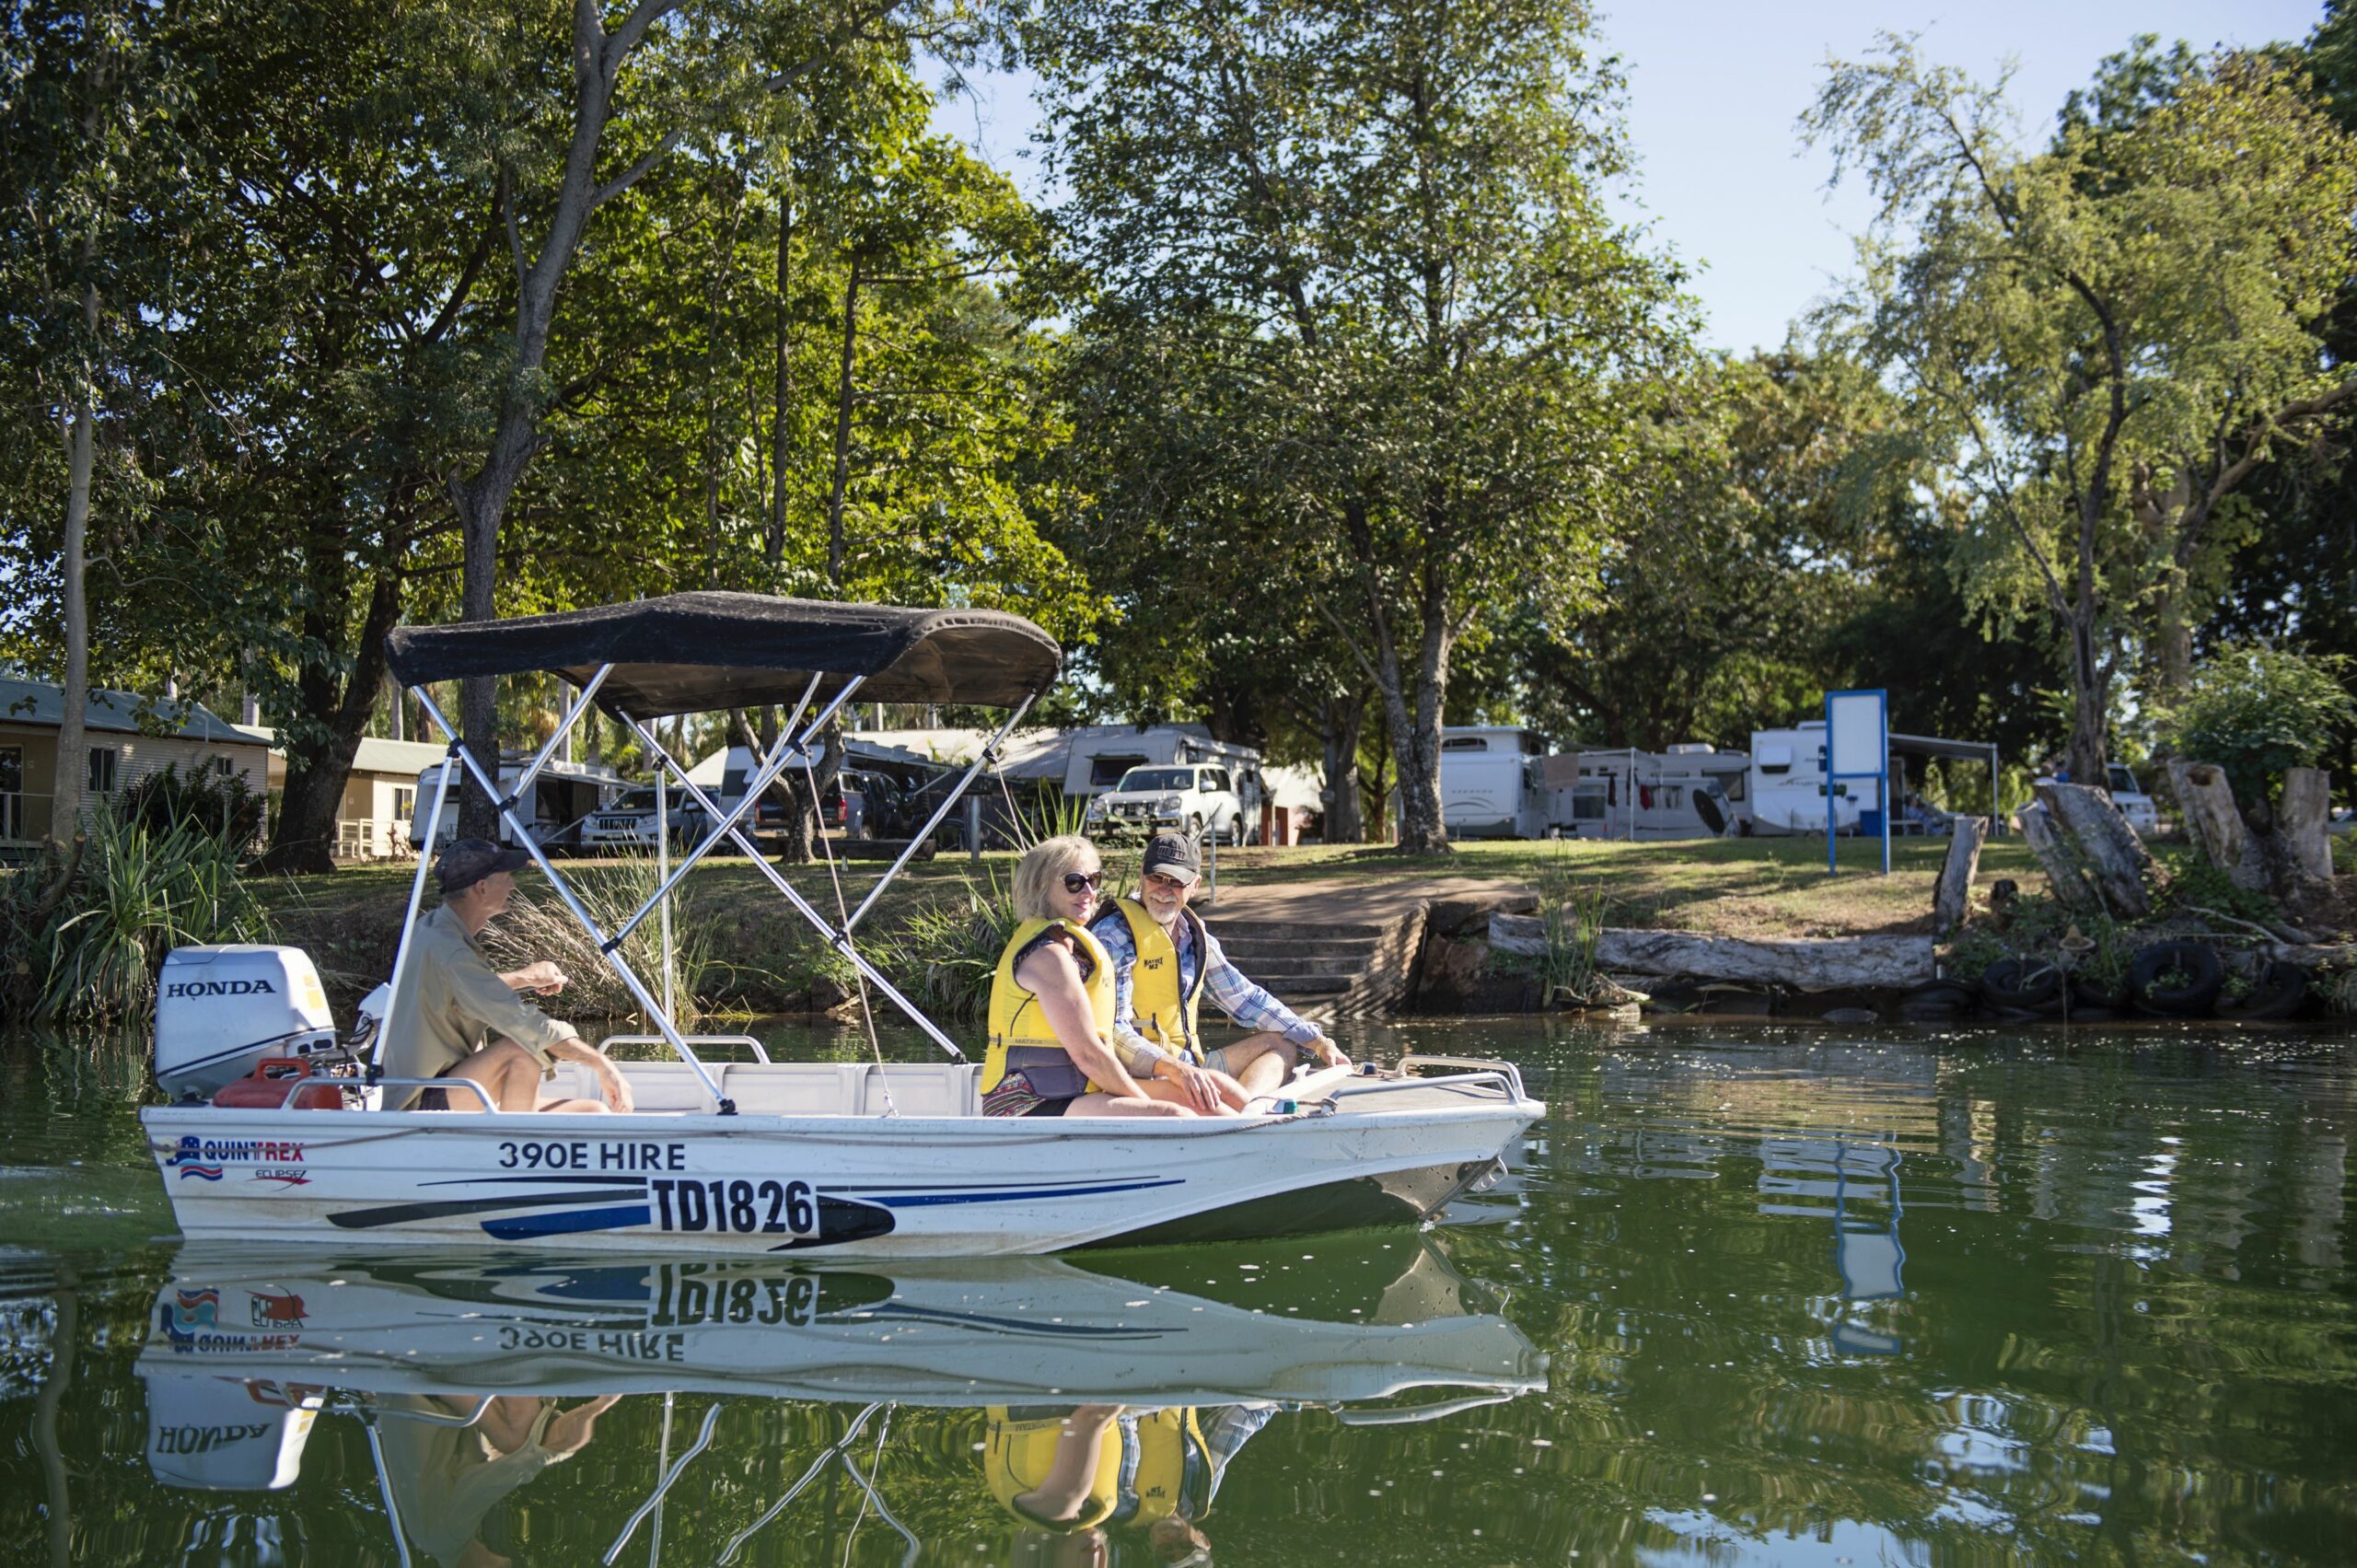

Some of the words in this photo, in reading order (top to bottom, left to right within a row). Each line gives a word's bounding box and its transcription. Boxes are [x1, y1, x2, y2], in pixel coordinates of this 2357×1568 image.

[167, 980, 276, 998] HONDA
[204, 1140, 305, 1162] QUINTREX
[498, 1142, 588, 1170] 390E
[599, 1143, 686, 1171] HIRE
[652, 1179, 813, 1234] TD1826
